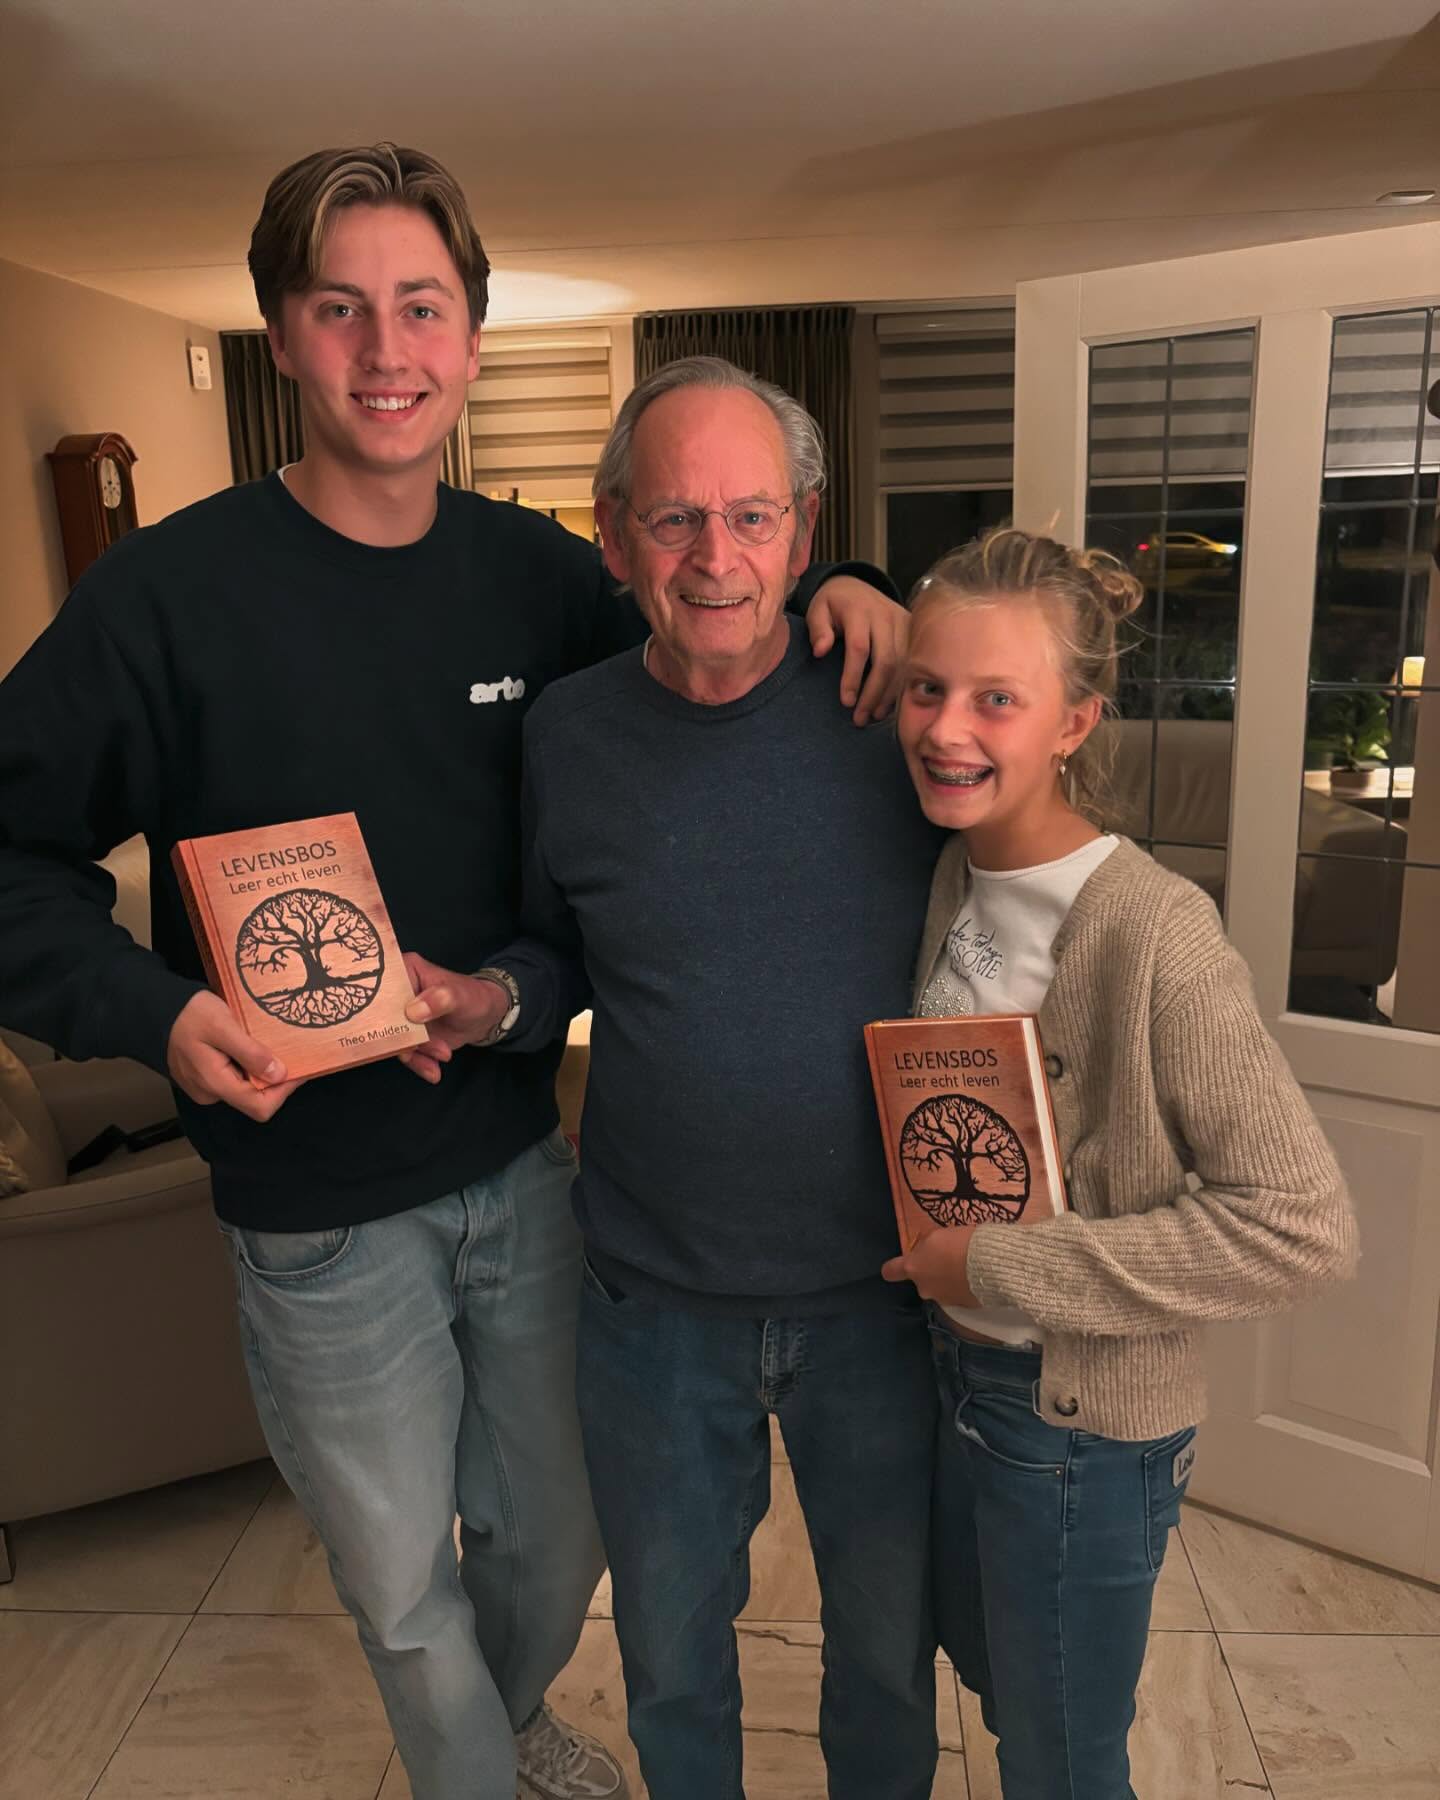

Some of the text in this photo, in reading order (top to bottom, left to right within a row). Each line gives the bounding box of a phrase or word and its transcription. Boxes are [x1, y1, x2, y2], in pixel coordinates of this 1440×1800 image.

[221, 840, 337, 878] LEVENSBOS
[229, 863, 342, 895] Leer echt leven
[949, 940, 1002, 980] ESOME
[337, 1023, 410, 1048] Theo Mulders
[894, 1049, 998, 1071] LEVENSBOS
[900, 1072, 1000, 1089] Leer echt leven
